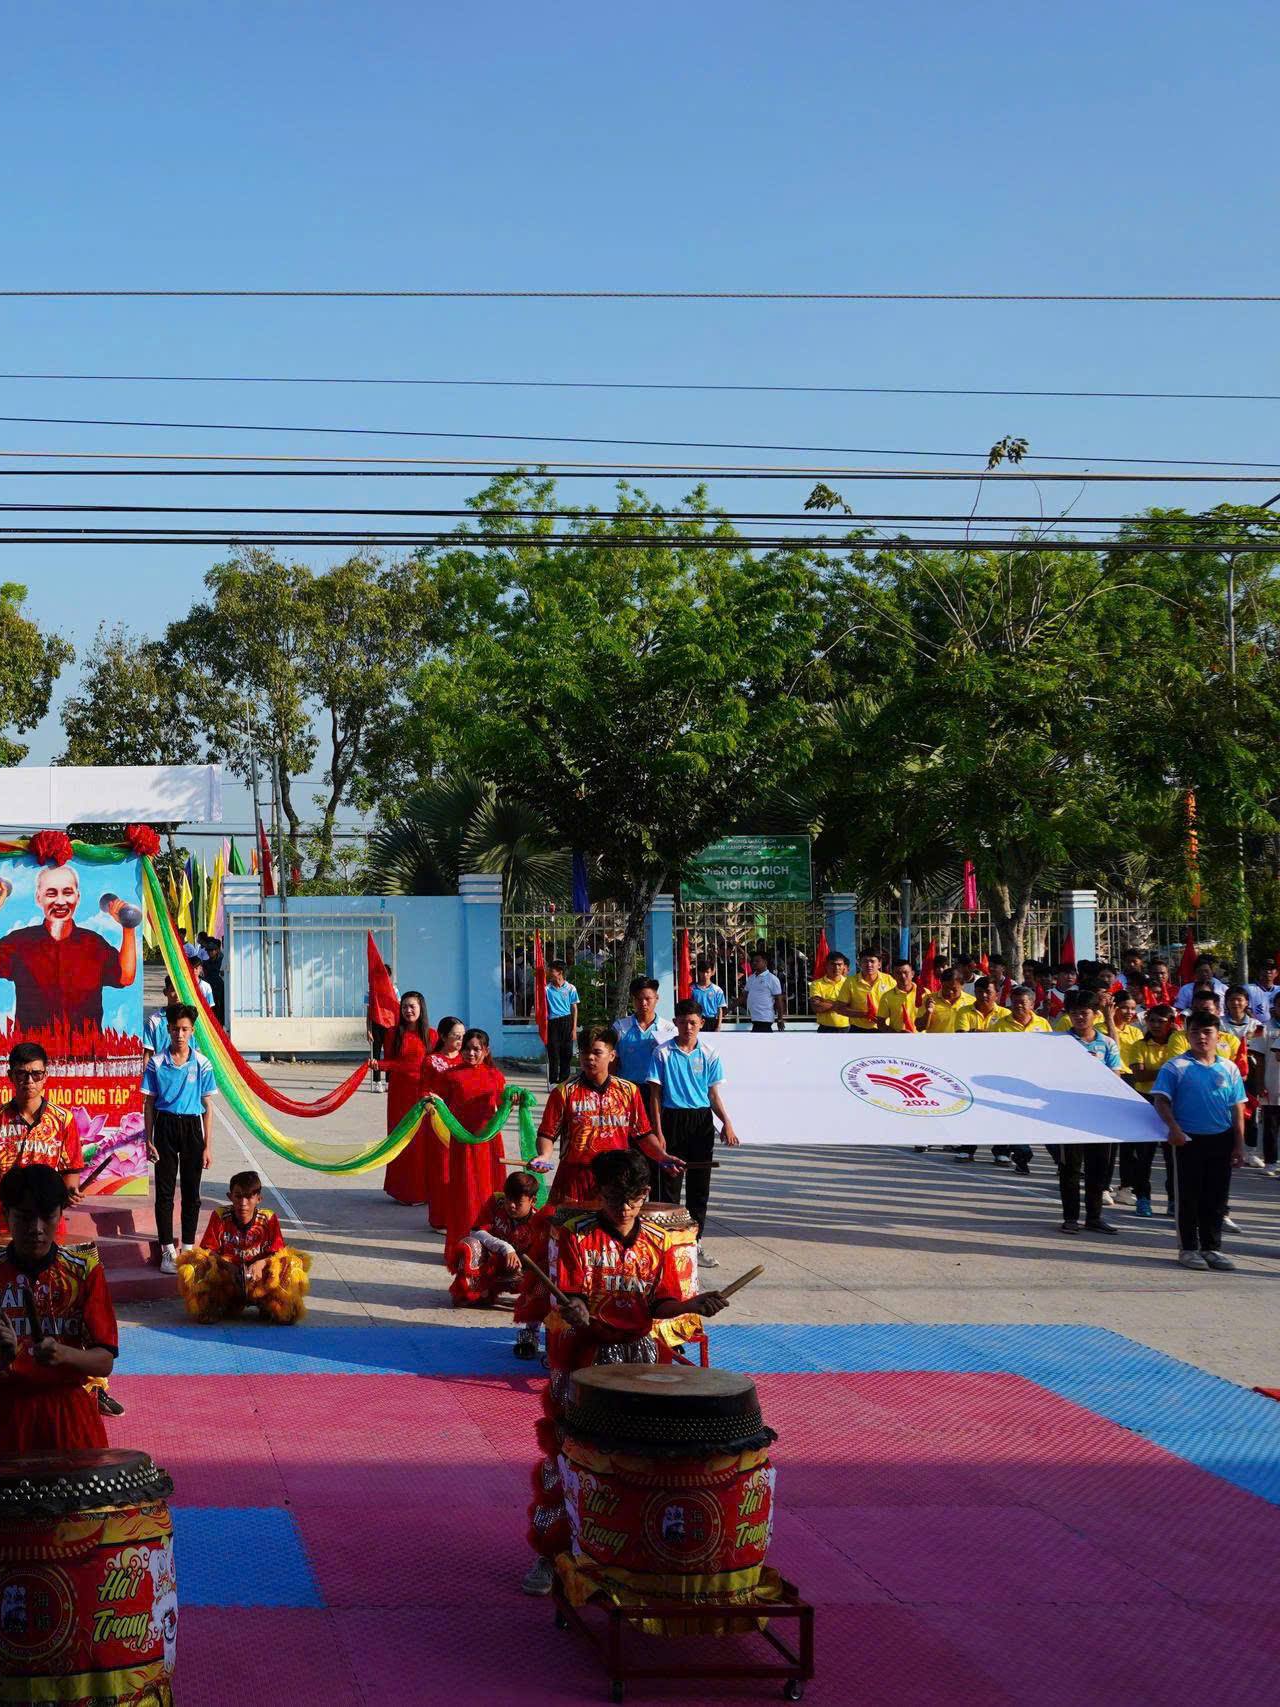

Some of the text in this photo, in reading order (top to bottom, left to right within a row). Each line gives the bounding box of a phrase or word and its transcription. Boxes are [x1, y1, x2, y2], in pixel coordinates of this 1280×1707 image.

[730, 866, 759, 875] GIAO
[48, 1085, 72, 1105] NÀO
[75, 1087, 106, 1105] CŨNG
[97, 1566, 142, 1601] Hải
[92, 1608, 150, 1649] Trang
